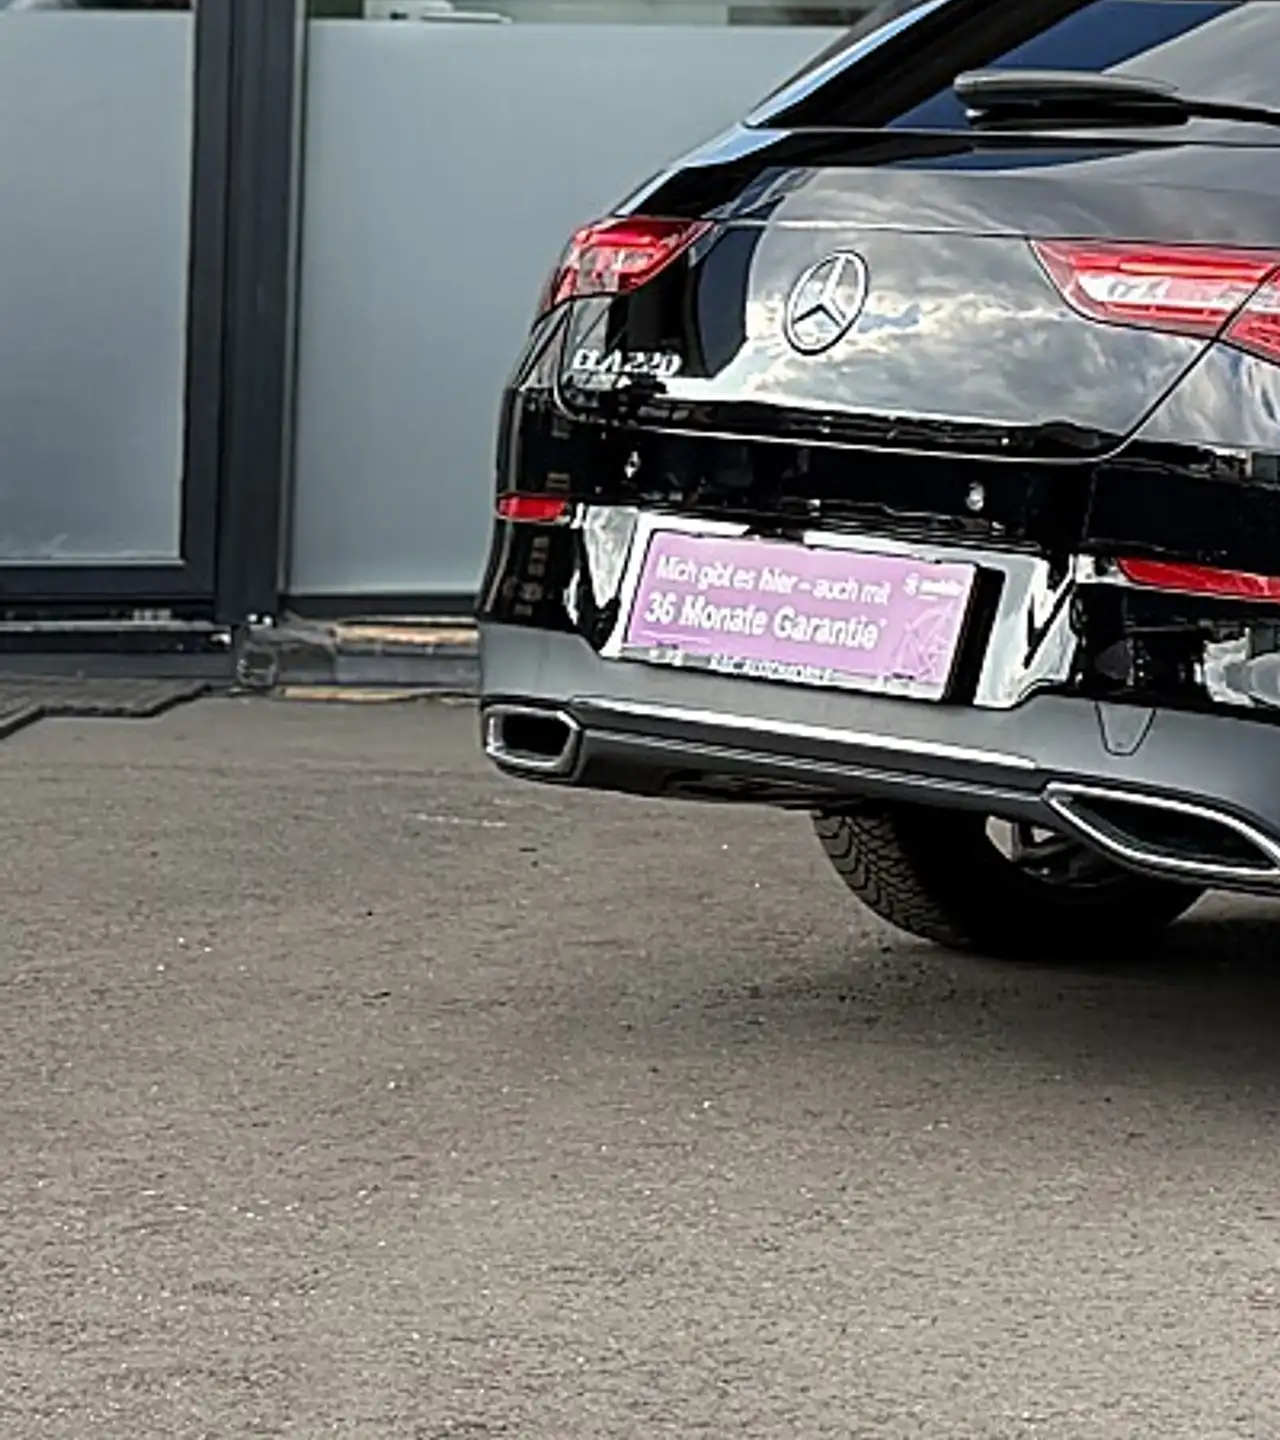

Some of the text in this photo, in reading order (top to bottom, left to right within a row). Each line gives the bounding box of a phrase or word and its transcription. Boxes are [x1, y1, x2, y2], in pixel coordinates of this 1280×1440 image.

[656, 554, 697, 582] Mich
[698, 561, 733, 590] gibt
[733, 568, 757, 591] es
[758, 566, 799, 594] hier
[812, 577, 858, 602] auch
[860, 581, 892, 606] mit
[644, 591, 677, 625] 36
[678, 593, 769, 636] Monate
